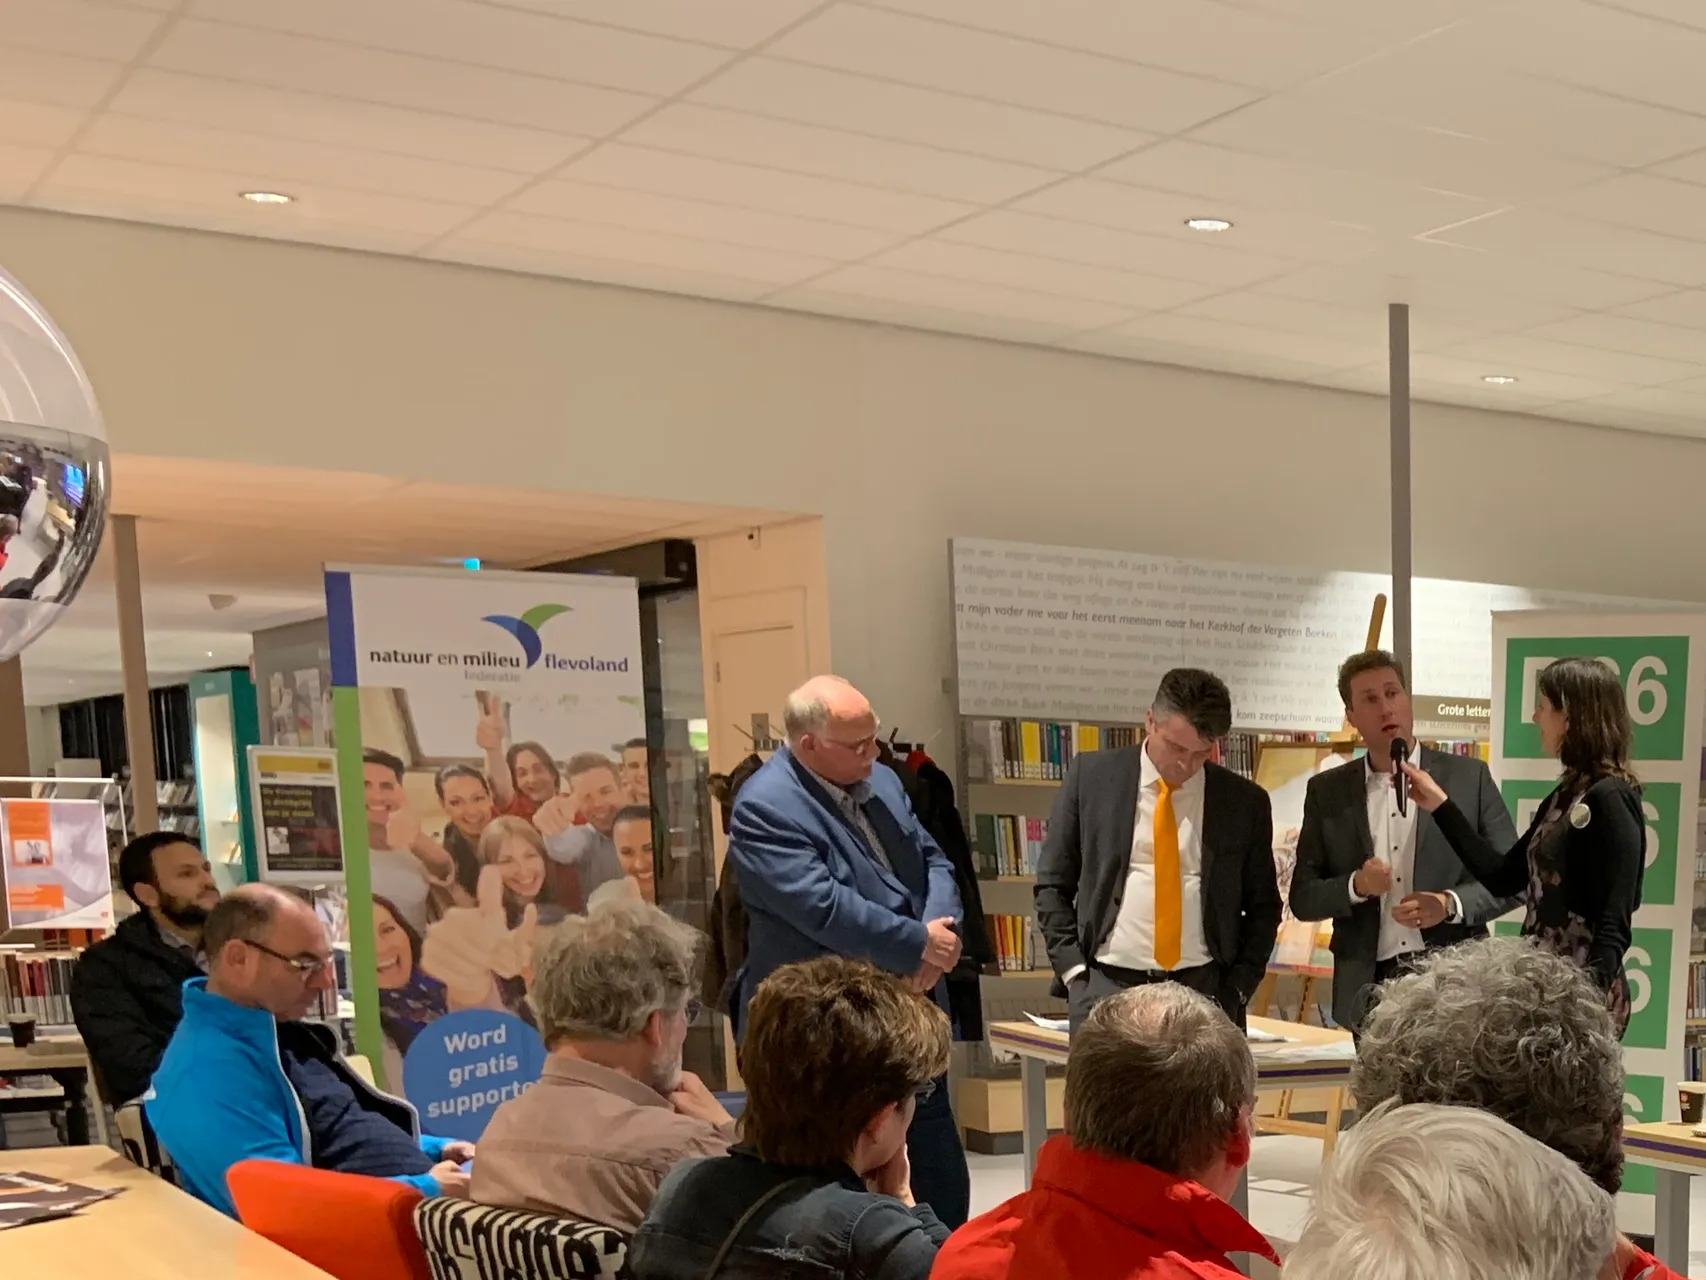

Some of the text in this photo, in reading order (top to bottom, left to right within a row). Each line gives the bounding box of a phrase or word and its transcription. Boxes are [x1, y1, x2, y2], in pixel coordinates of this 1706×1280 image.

[968, 603, 991, 618] mijn
[994, 604, 1024, 617] vader
[1027, 608, 1044, 619] me
[1072, 608, 1089, 622] het
[1190, 618, 1205, 631] het
[1207, 619, 1246, 636] Kerkhof
[369, 649, 630, 673] natuur en milieu flevoland
[1437, 702, 1465, 718] Grote
[443, 1023, 507, 1055] Word
[448, 1053, 519, 1089] gratis
